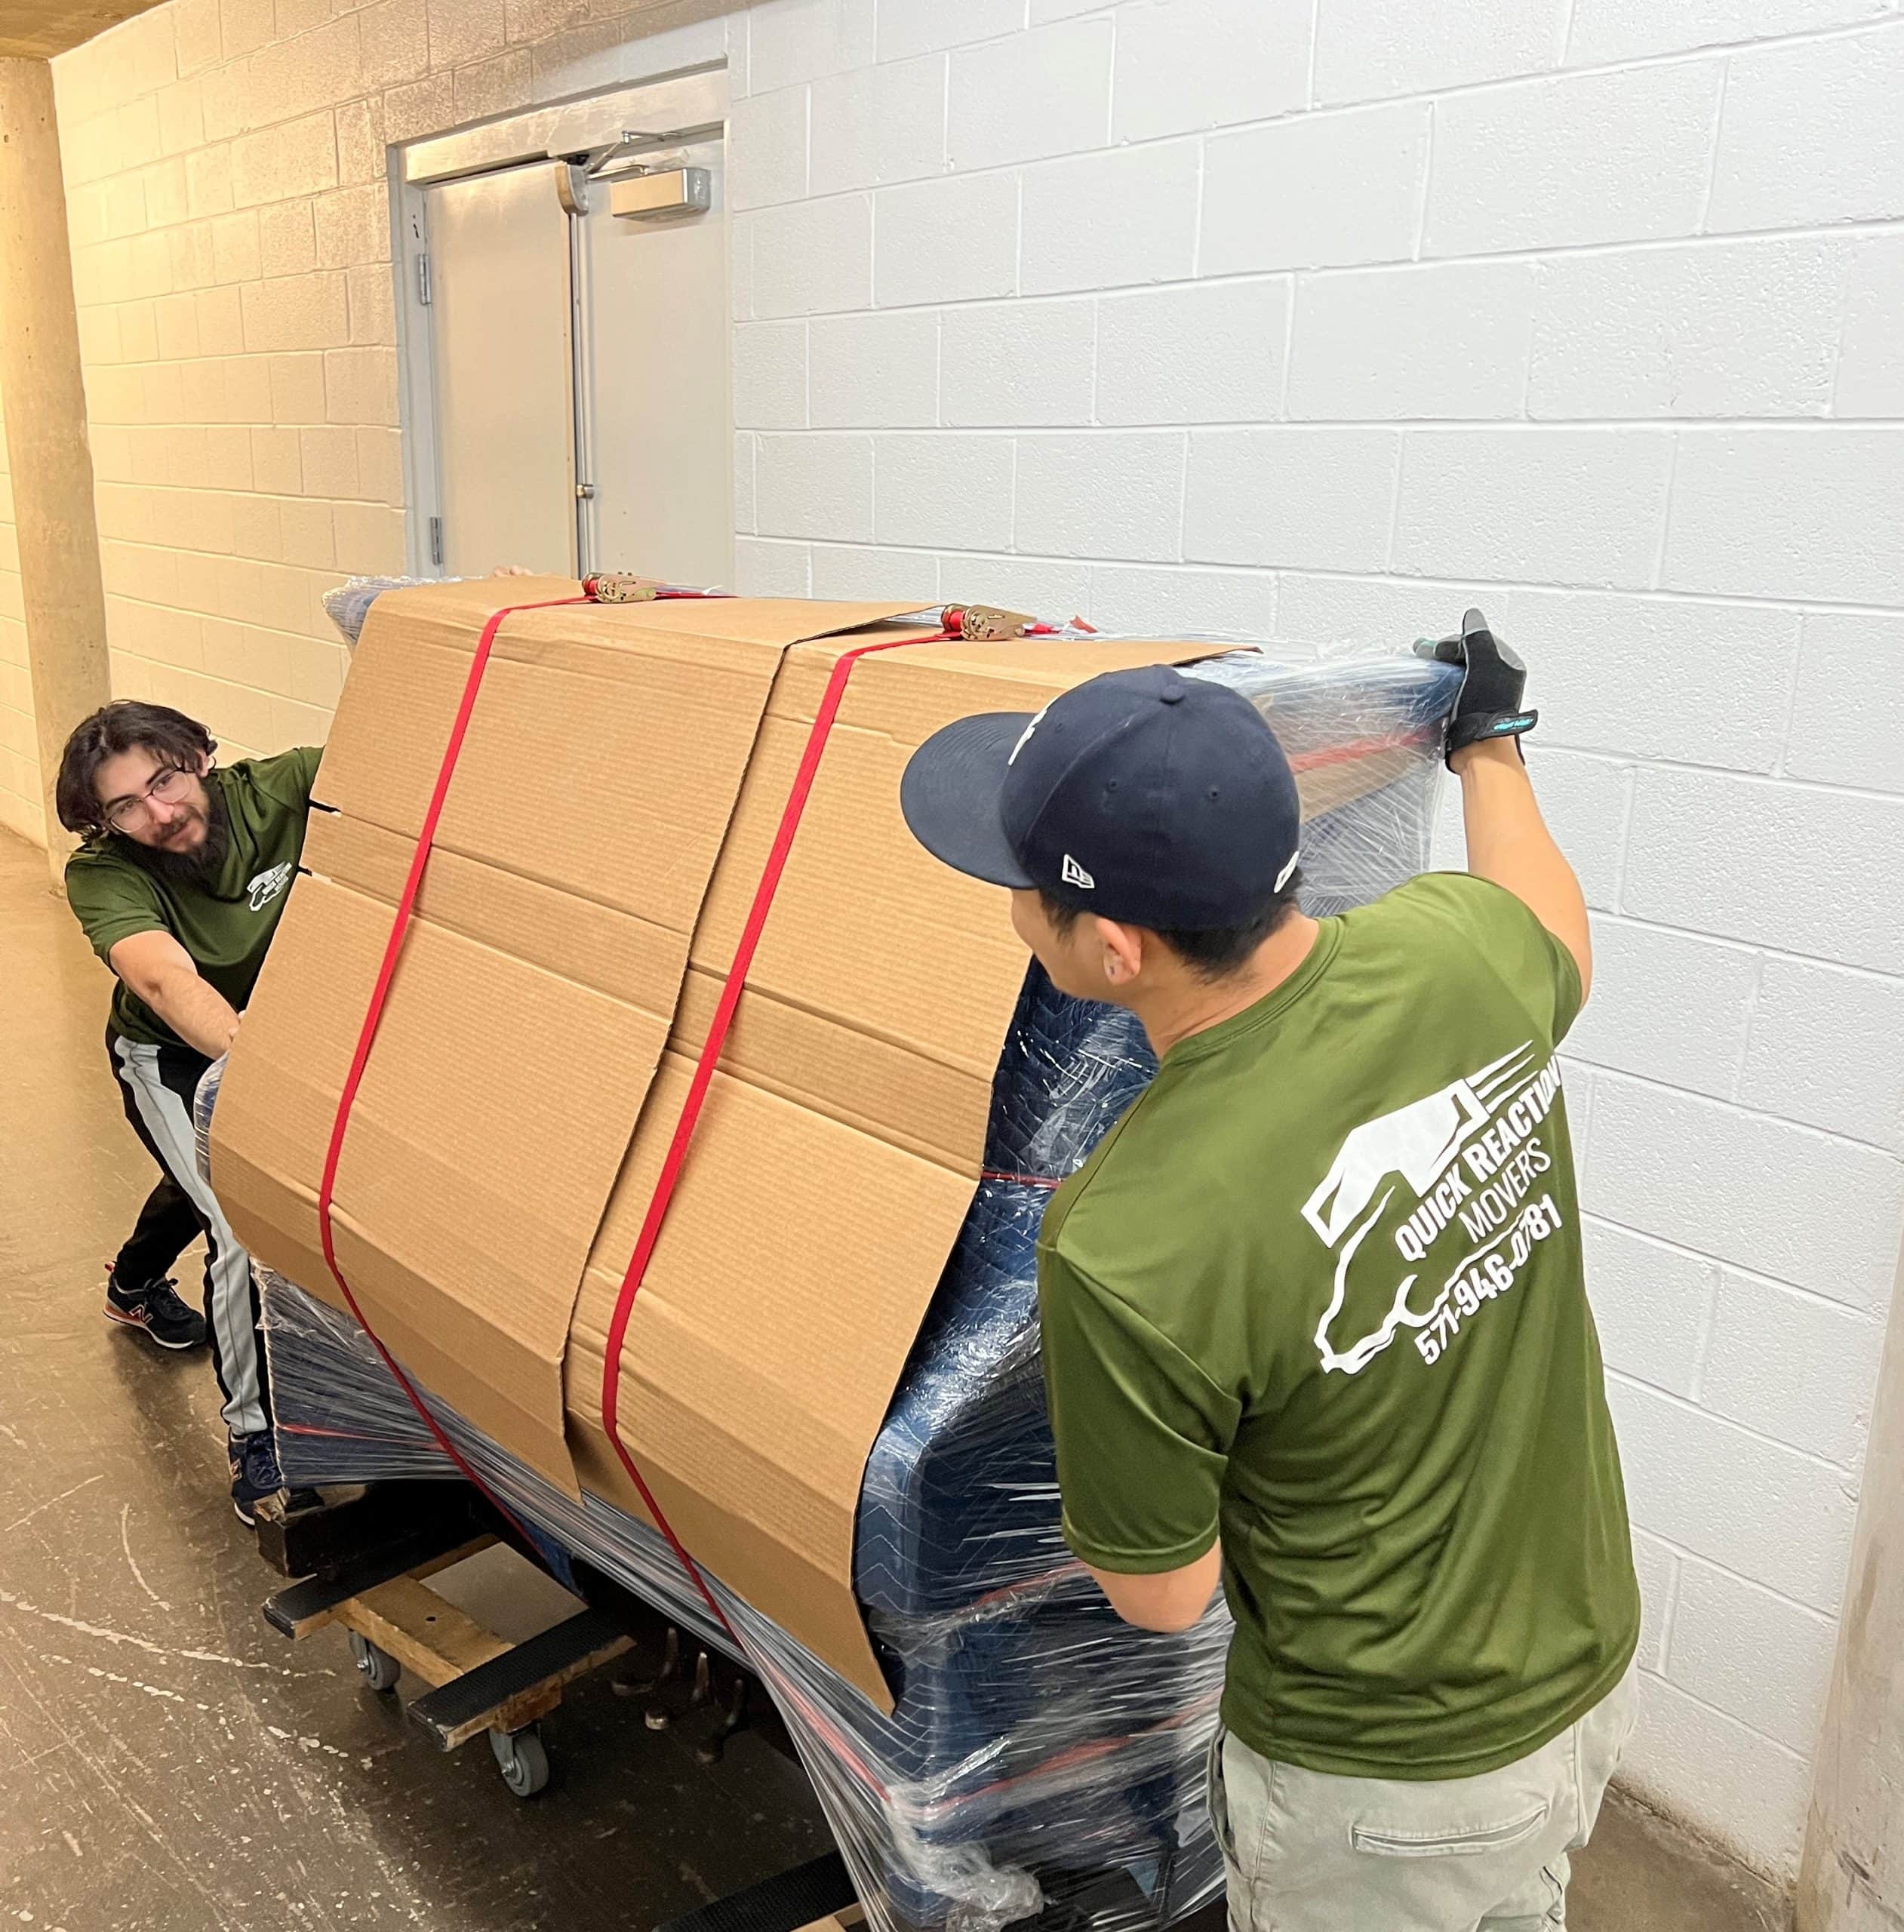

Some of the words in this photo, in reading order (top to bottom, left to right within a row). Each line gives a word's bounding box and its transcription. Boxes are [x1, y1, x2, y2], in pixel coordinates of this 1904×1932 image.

[1395, 1163, 1472, 1262] QUICK
[1461, 1055, 1561, 1183] REACTION
[1458, 1137, 1551, 1244] MOVERS
